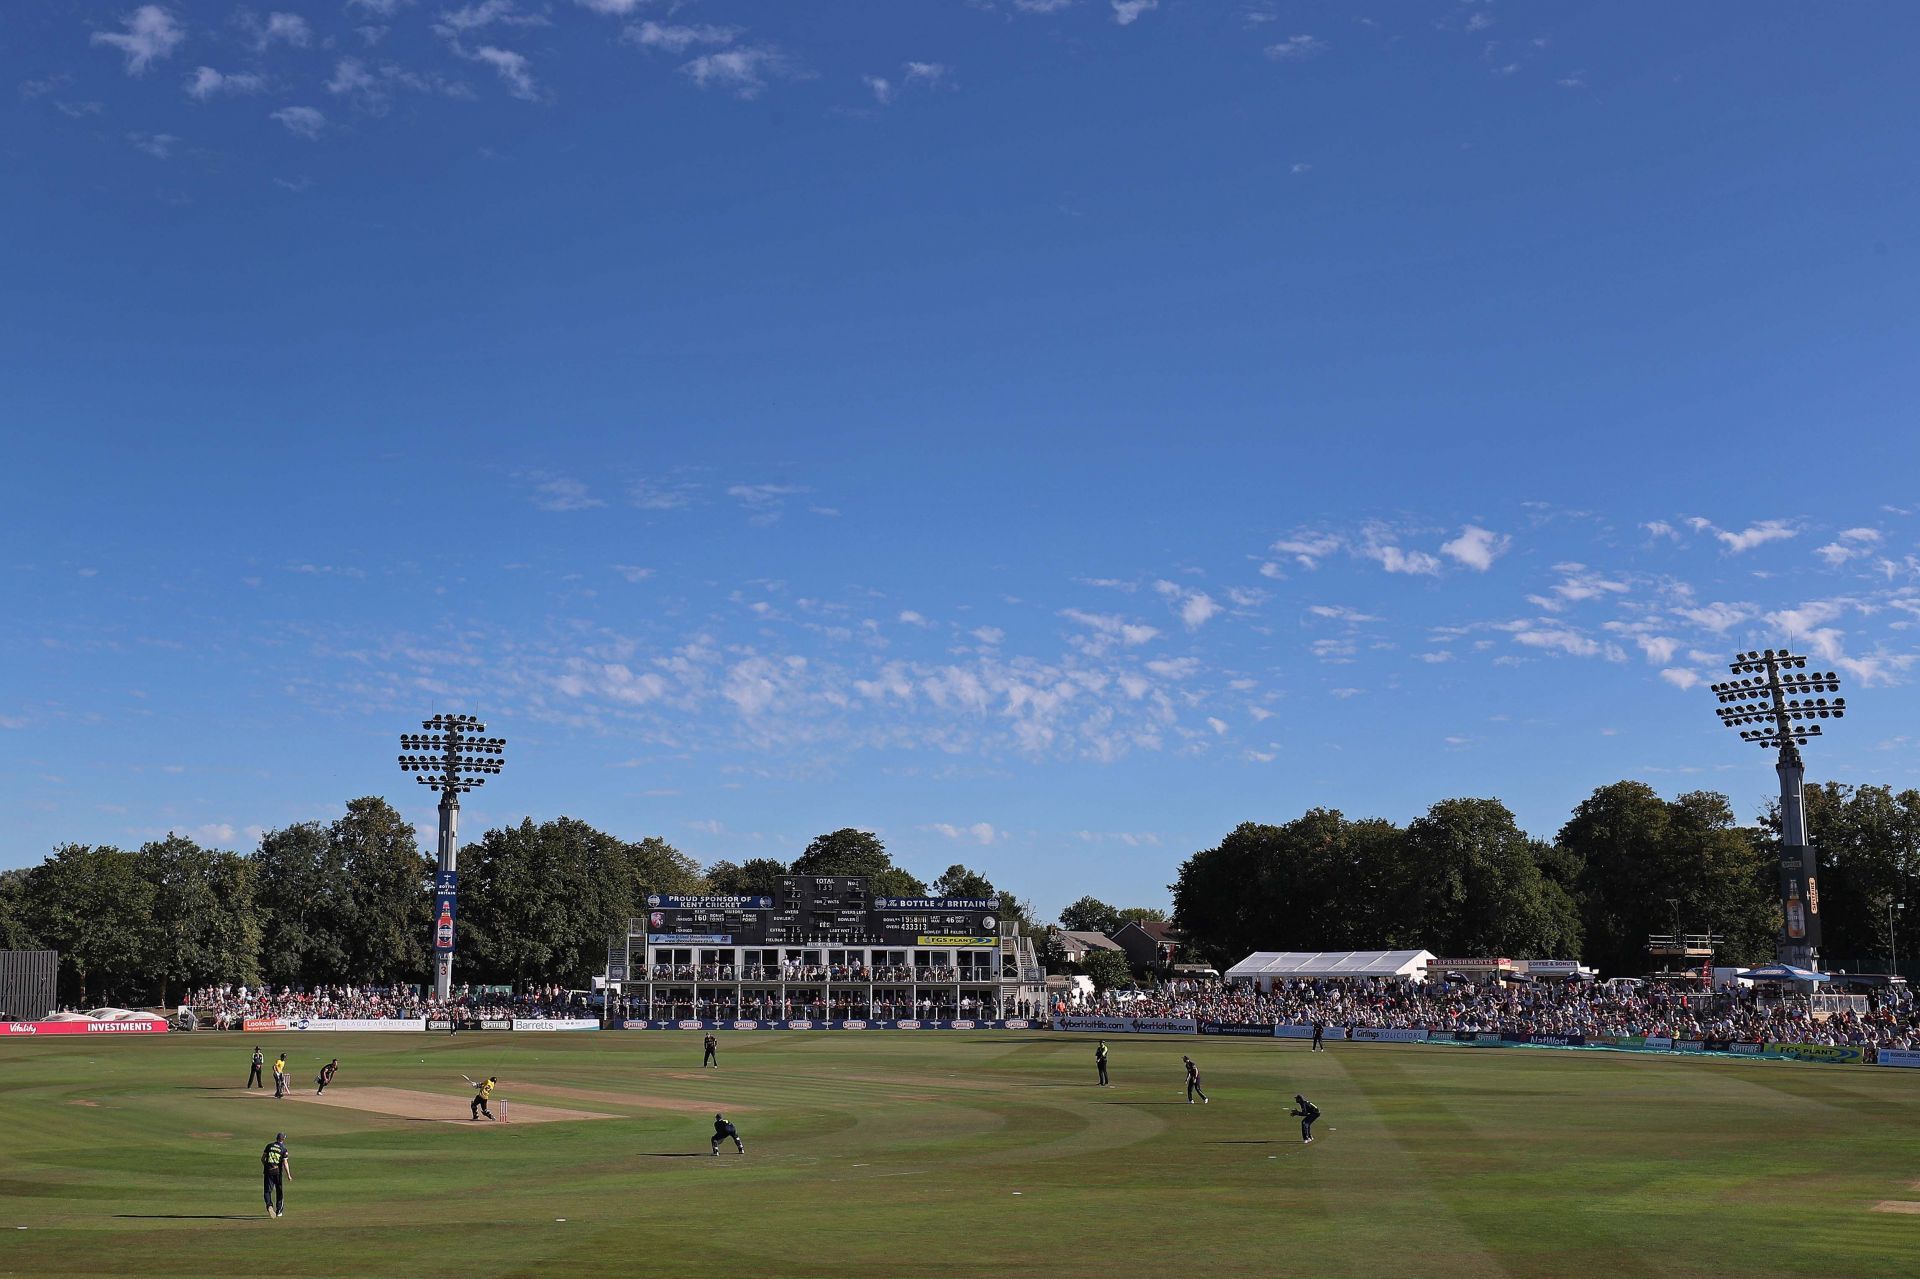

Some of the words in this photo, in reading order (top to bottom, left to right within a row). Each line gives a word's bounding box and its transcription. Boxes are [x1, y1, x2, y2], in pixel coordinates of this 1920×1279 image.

[441, 967, 446, 975] 3
[10, 1022, 37, 1034] Vitality
[88, 1023, 152, 1032] INVESTMENTS
[516, 1021, 554, 1030] Barretts
[1059, 1018, 1124, 1031] CyberHotHits.com
[1130, 1019, 1194, 1032] CyberHotHits.com
[1356, 1030, 1379, 1039] Girlings
[1380, 1030, 1422, 1039] SOLICITORS
[1531, 1036, 1568, 1045] NatWest
[1731, 1044, 1759, 1052] SPITFIRE
